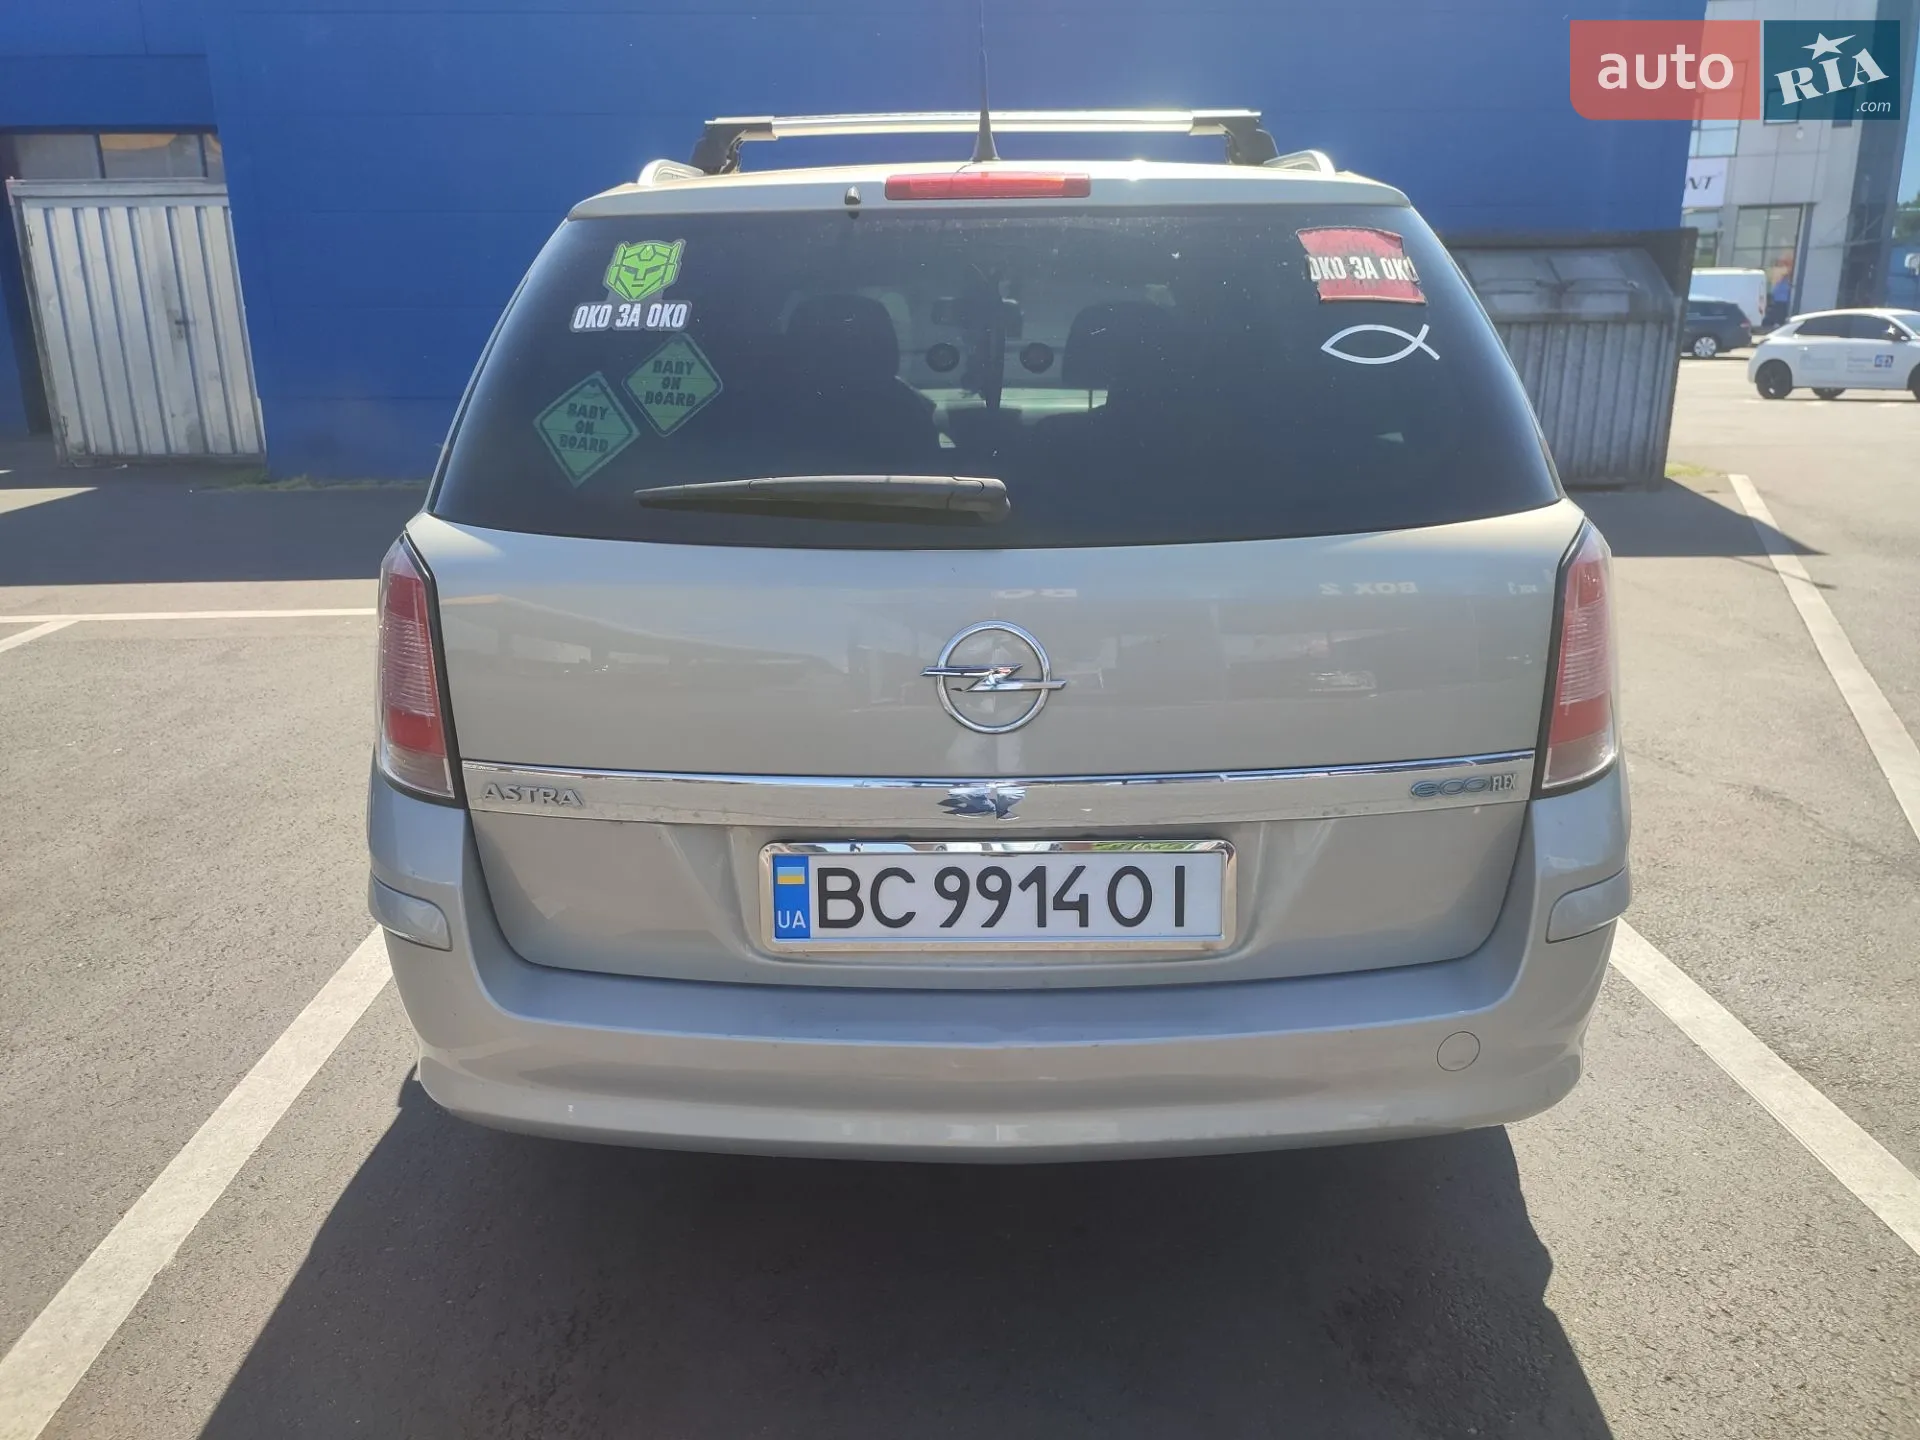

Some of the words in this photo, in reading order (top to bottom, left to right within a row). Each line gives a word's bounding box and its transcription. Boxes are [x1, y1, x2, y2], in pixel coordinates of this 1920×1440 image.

[652, 360, 695, 376] BABY
[661, 376, 682, 391] ON
[645, 391, 696, 408] BOARD
[566, 403, 610, 421] BABY
[575, 420, 595, 436] ON
[559, 434, 609, 453] BOARD
[484, 783, 584, 807] ASTRA
[817, 866, 917, 929] BC
[933, 865, 1090, 929] 9914
[1107, 865, 1186, 928] OI
[777, 910, 806, 929] UA
